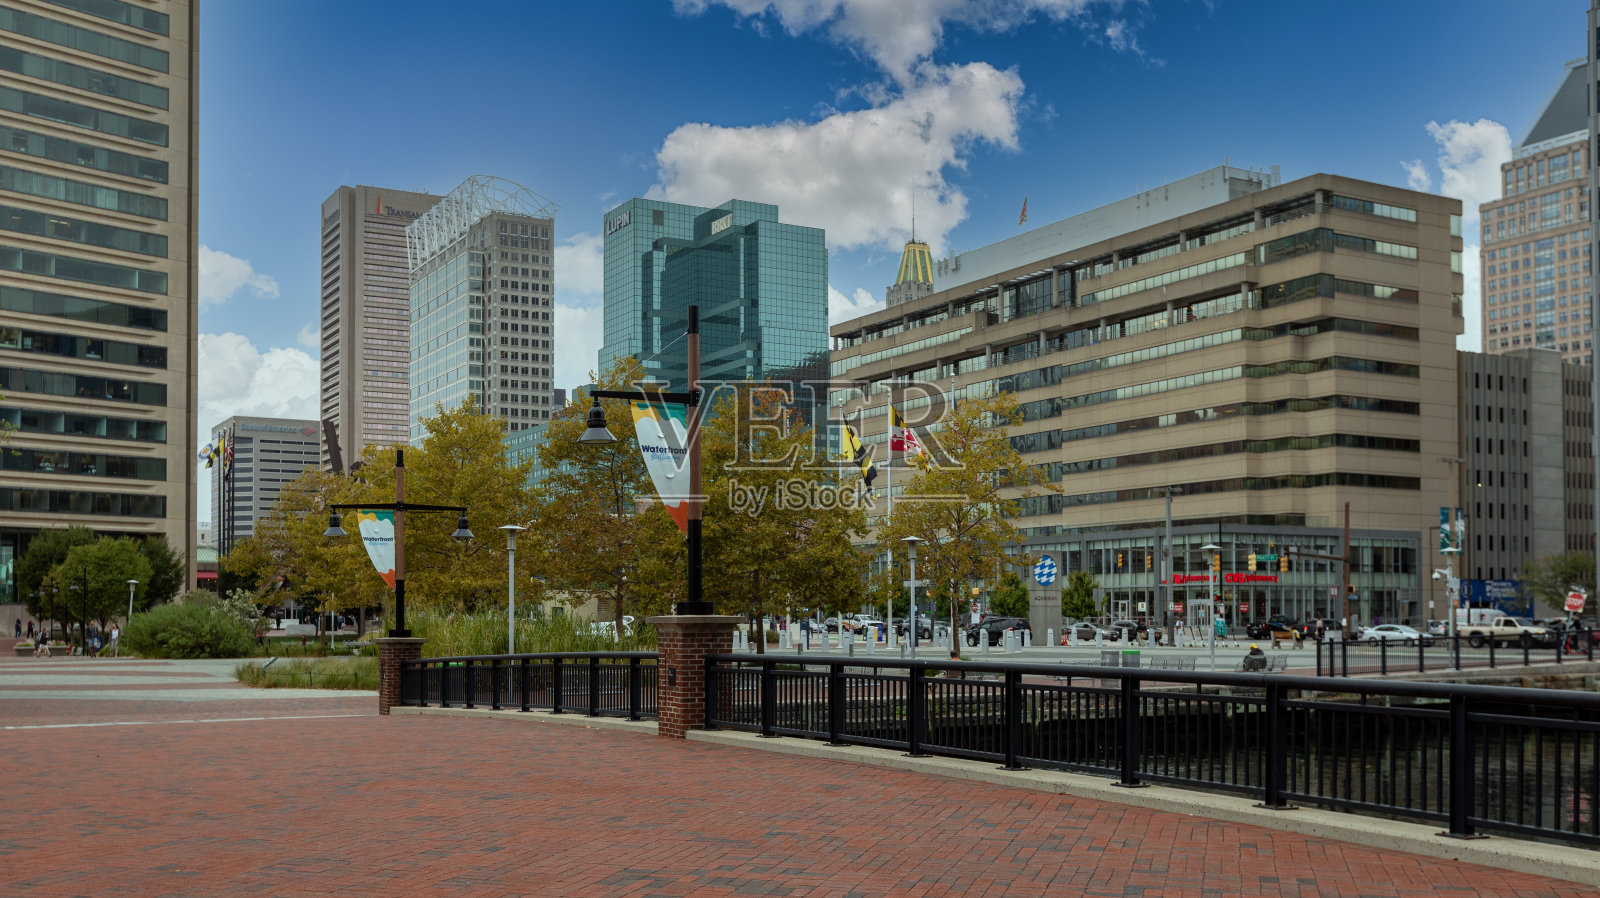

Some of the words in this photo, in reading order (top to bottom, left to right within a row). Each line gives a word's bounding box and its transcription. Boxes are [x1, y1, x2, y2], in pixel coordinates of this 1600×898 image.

[607, 210, 631, 235] LUPIN
[641, 444, 688, 455] Waterfront
[1225, 573, 1278, 583] CVS/pharmacy
